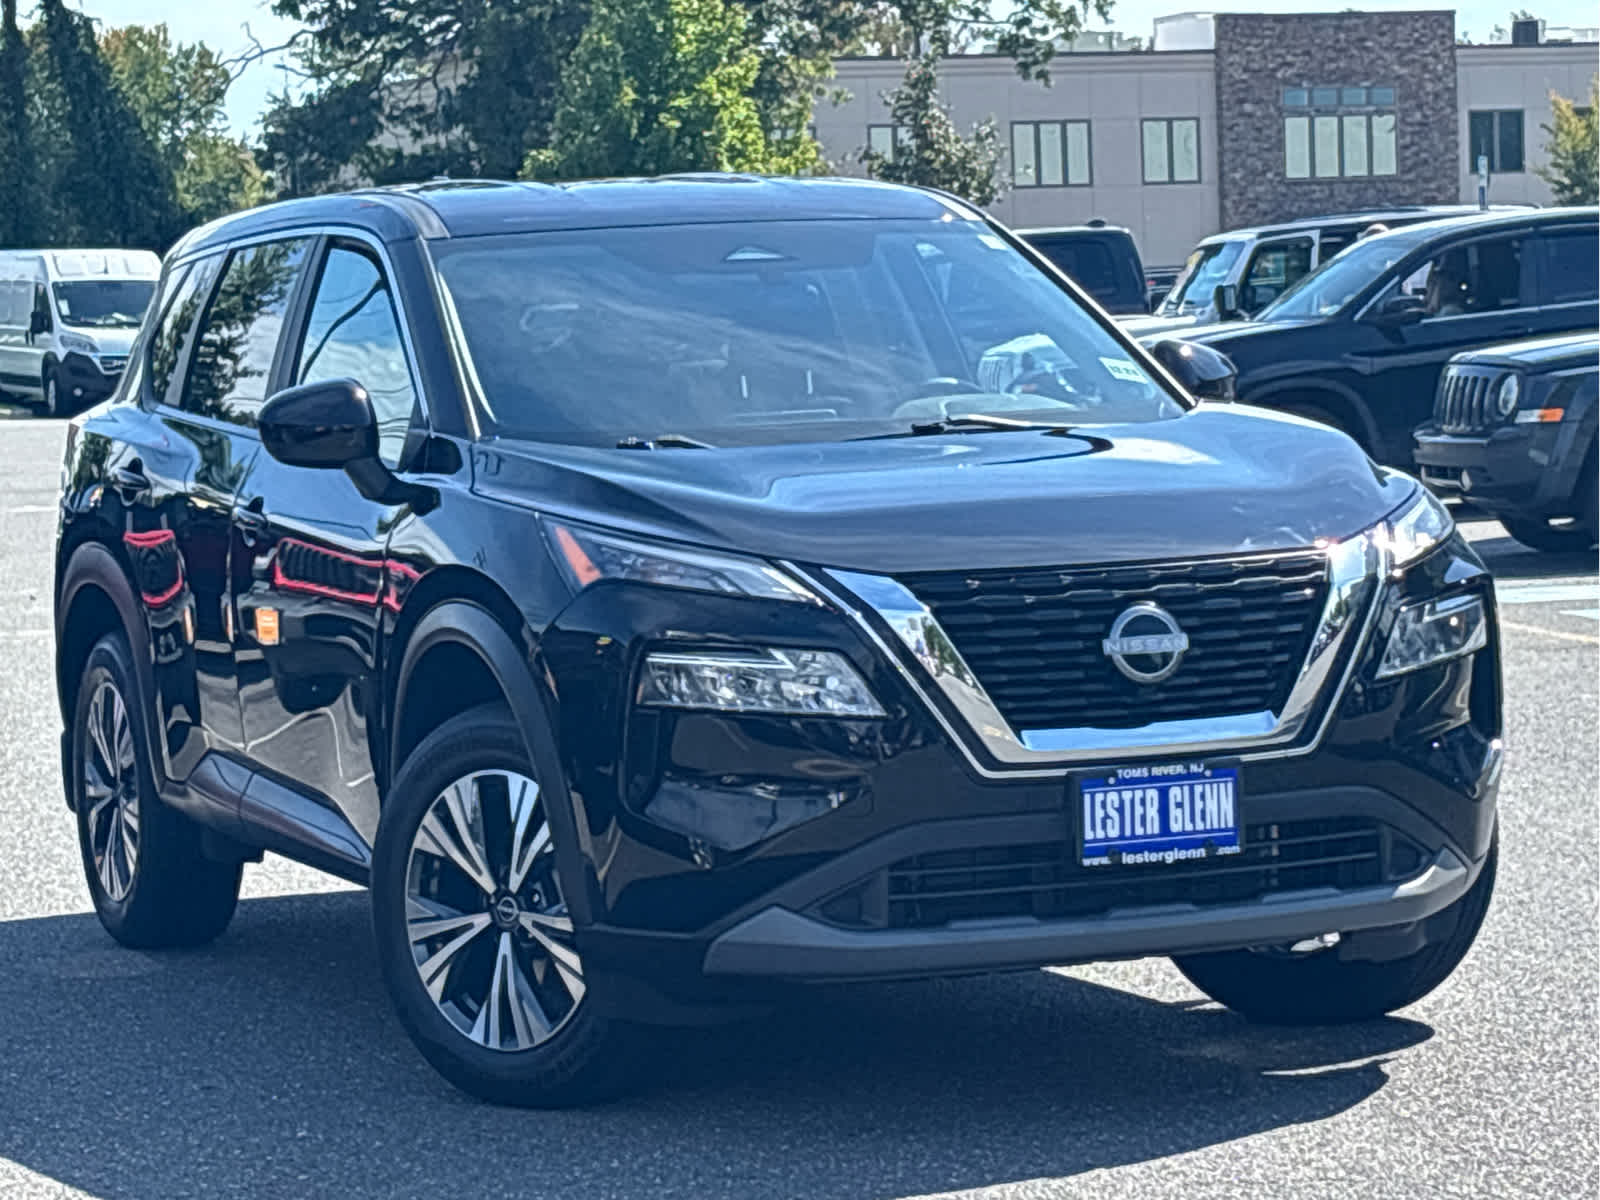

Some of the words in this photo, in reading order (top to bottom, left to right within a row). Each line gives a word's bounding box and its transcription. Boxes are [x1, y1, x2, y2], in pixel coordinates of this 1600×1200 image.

[1104, 636, 1186, 653] NISSAN
[1117, 768, 1148, 779] TOMS
[1190, 763, 1204, 773] NJ
[1084, 788, 1160, 841] LESTER
[1169, 781, 1235, 833] GLENN
[1122, 847, 1206, 865] lesterglenn
